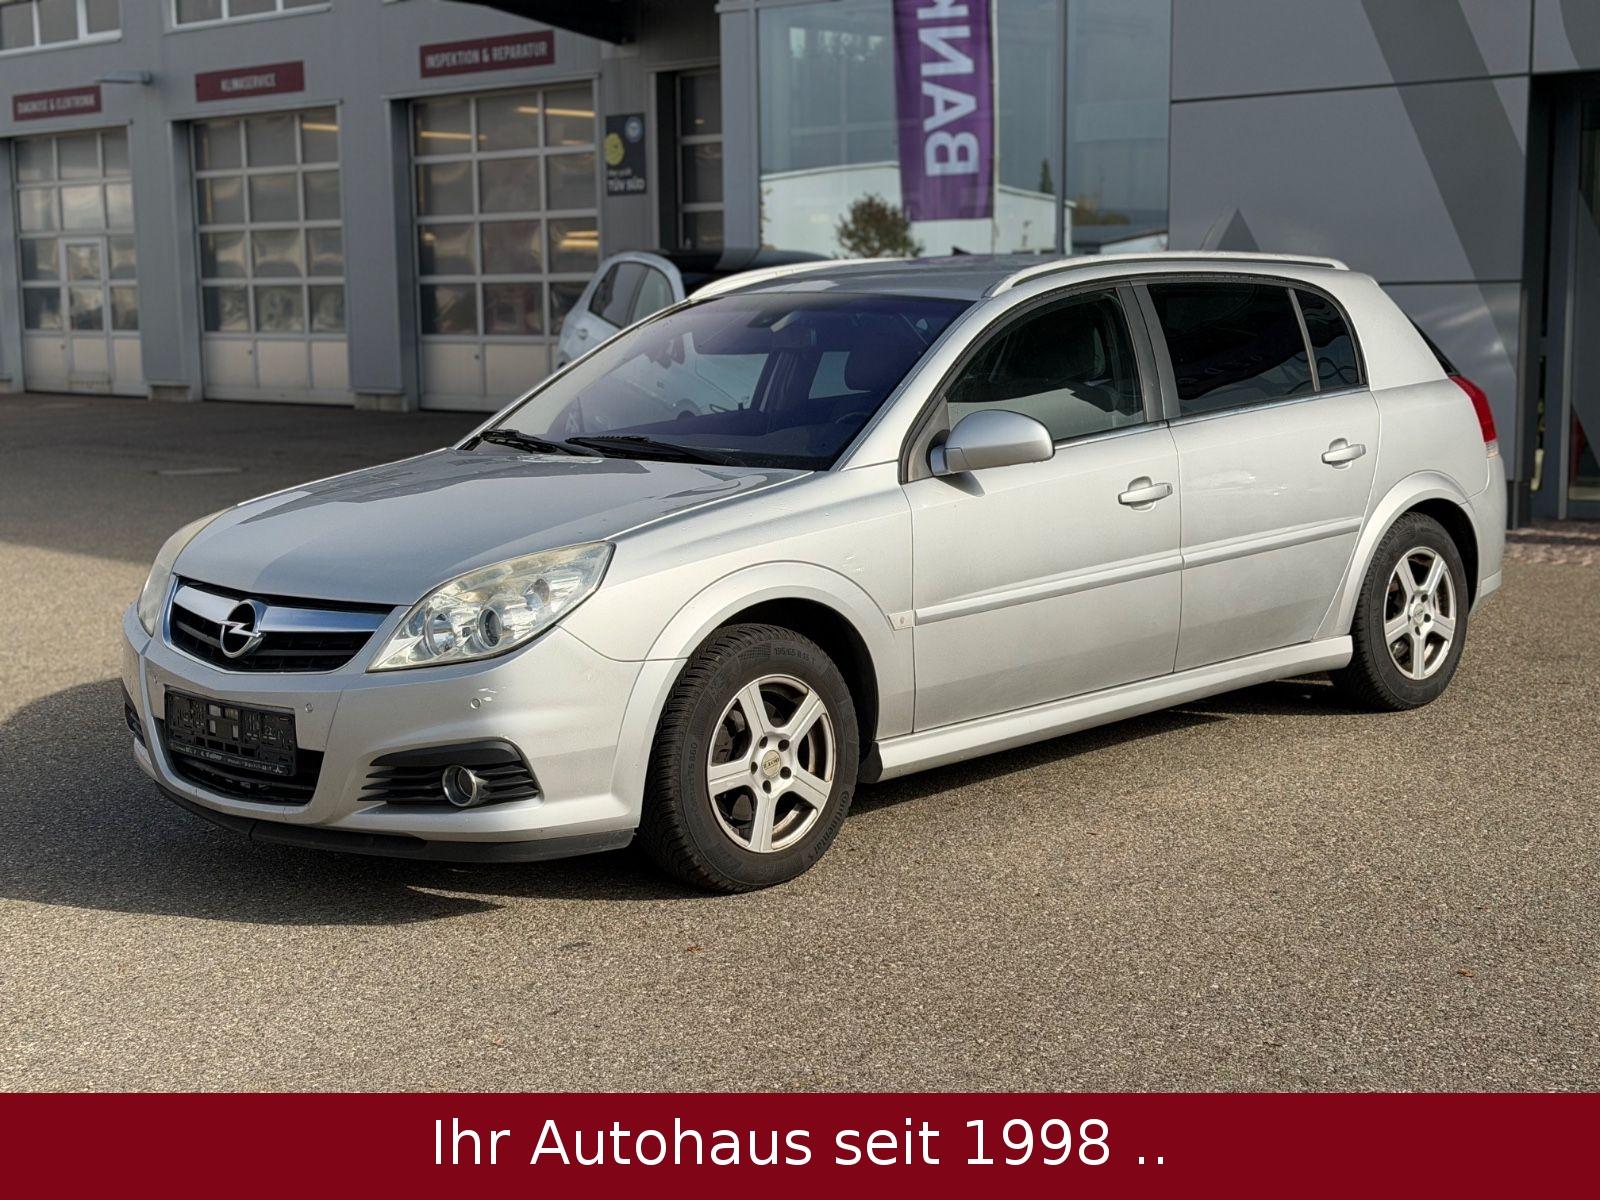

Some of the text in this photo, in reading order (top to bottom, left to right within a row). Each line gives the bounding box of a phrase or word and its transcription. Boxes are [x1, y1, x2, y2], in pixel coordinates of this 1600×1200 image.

[426, 42, 547, 68] INSPEKTION & REPARATUR
[814, 790, 850, 854] Continental
